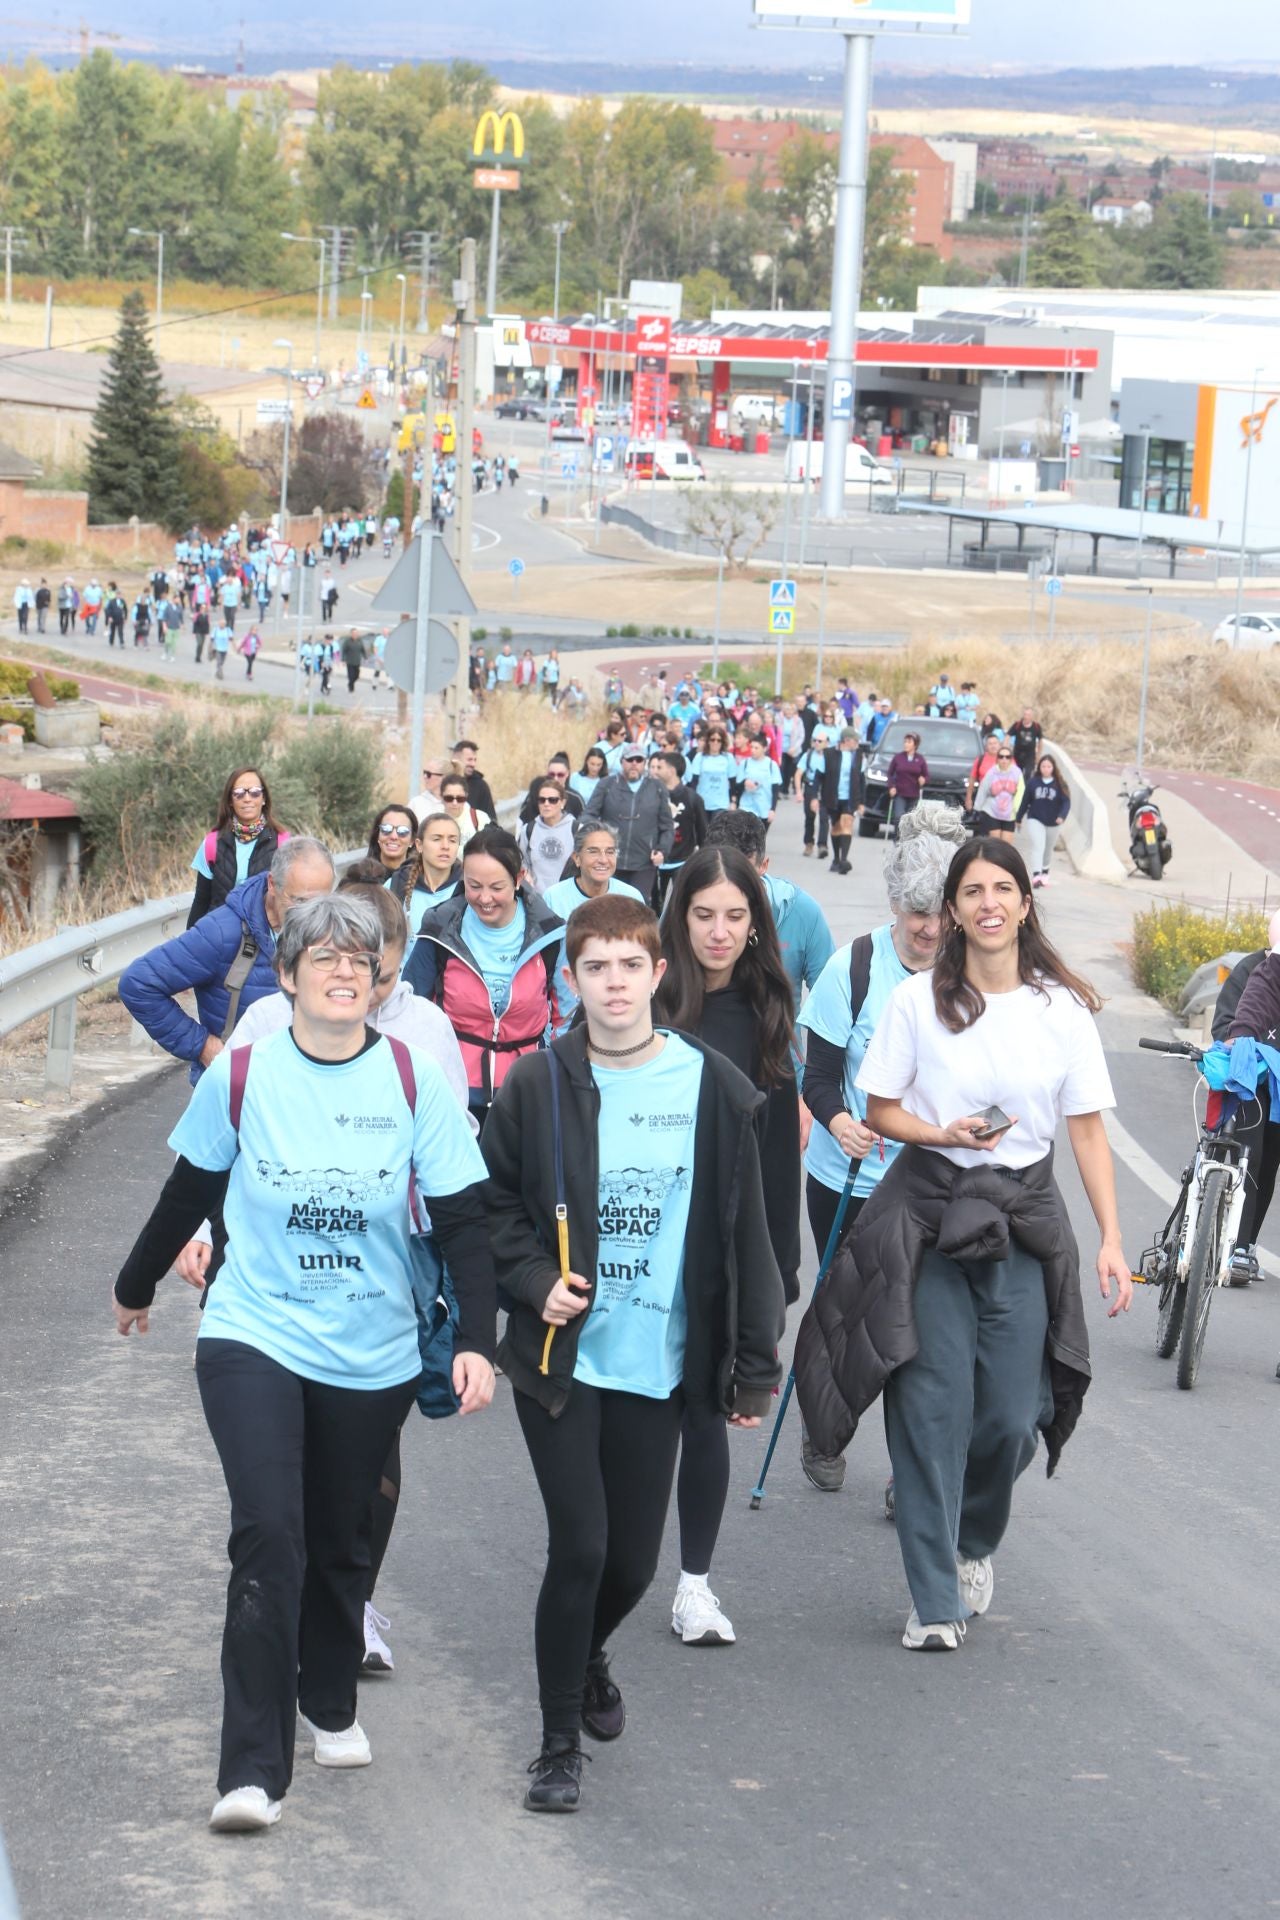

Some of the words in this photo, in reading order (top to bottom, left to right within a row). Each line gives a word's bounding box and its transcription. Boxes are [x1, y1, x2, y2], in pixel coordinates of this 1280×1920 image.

[540, 327, 570, 343] CEPSA
[637, 341, 667, 351] CEPSA
[833, 380, 852, 407] P
[596, 437, 613, 459] P
[292, 1203, 363, 1219] Marcha
[286, 1216, 369, 1232] ASPACE
[643, 1300, 650, 1309] La
[652, 1302, 670, 1314] Rioja
